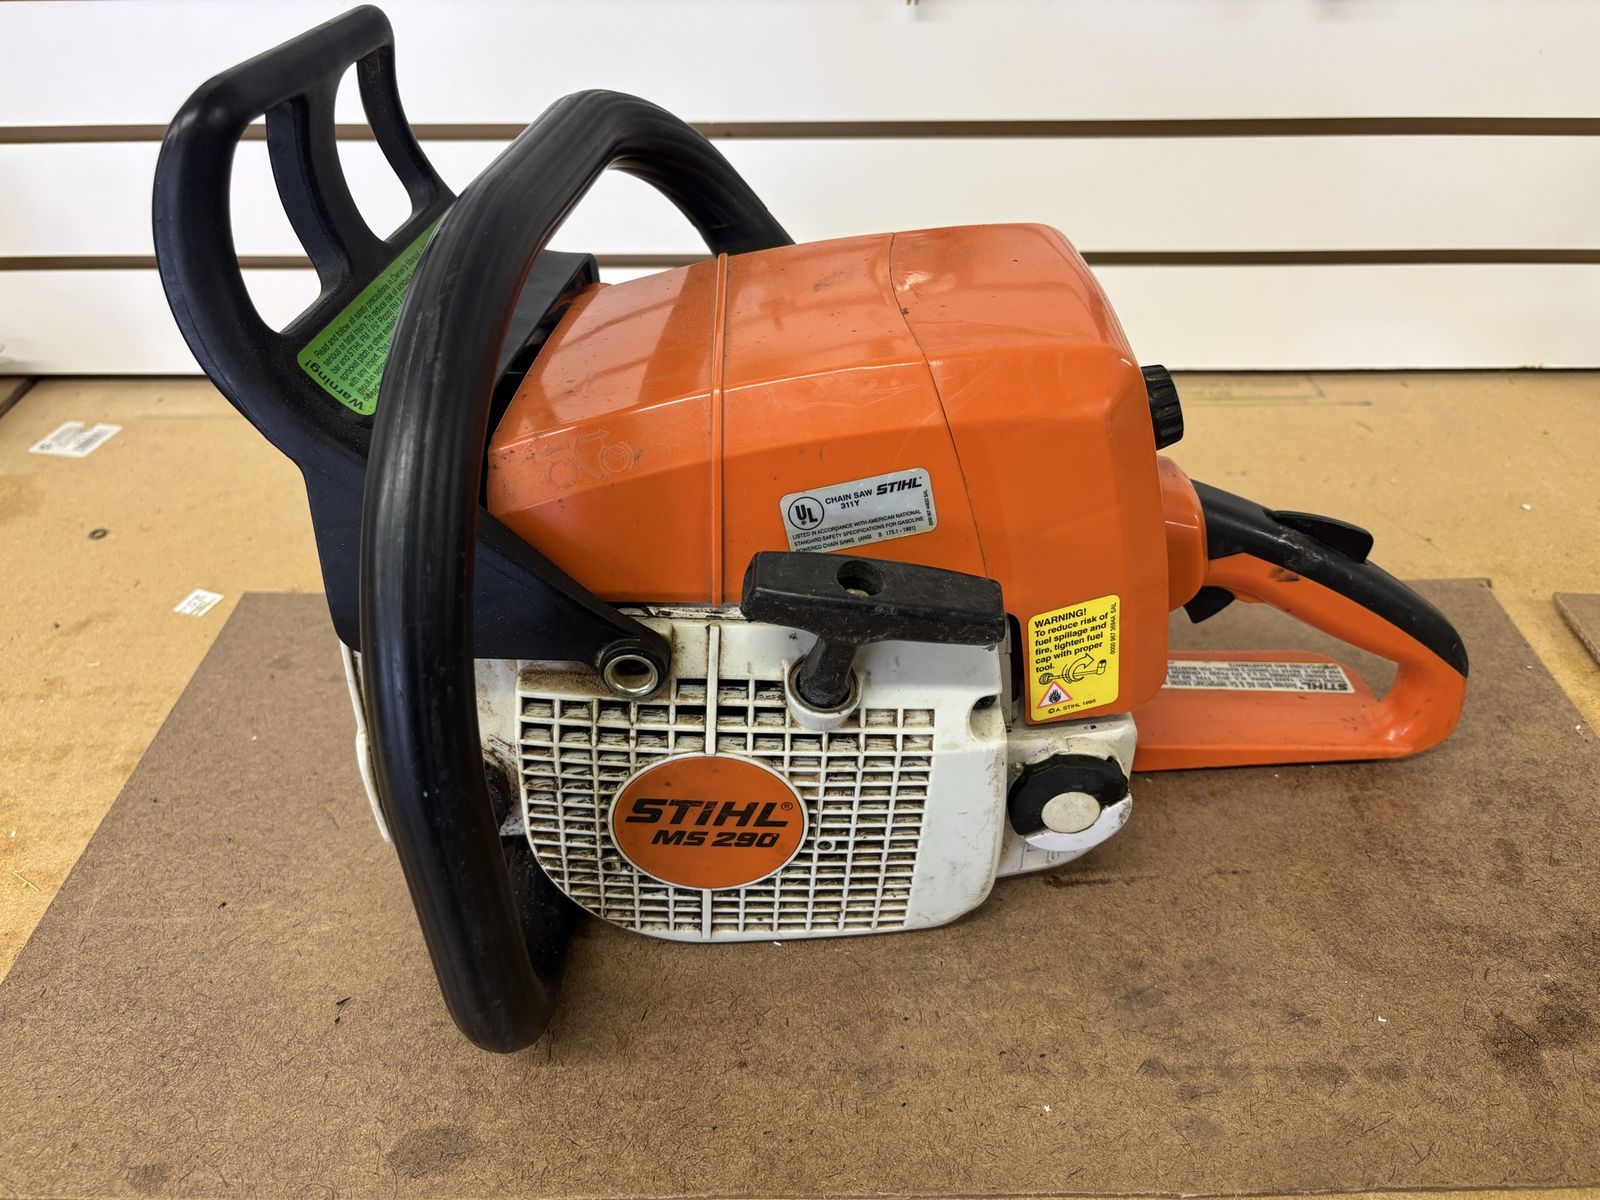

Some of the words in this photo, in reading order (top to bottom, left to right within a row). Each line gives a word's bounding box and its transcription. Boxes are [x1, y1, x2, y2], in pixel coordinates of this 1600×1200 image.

[313, 342, 331, 359] Read
[326, 333, 339, 347] and
[334, 321, 351, 338] follow
[352, 304, 369, 321] safety
[322, 347, 342, 367] serious
[338, 342, 348, 351] or
[343, 332, 356, 346] fatal
[364, 313, 374, 323] To
[369, 299, 388, 318] reduce
[330, 363, 342, 375] bar
[338, 354, 350, 366] and
[346, 339, 364, 357] STIHL
[338, 359, 361, 382] sprocket
[355, 347, 371, 363] pitch
[371, 331, 386, 347] other
[305, 361, 364, 410] Warning!
[825, 493, 852, 505] CHAIN
[853, 489, 873, 499] SAW
[875, 477, 922, 496] STIHL
[795, 504, 818, 523] UL
[840, 499, 860, 510] 311Y
[792, 531, 811, 540] LISTED
[817, 523, 854, 535] ACCORDANCE
[868, 514, 895, 525] AMERICAN
[896, 509, 921, 519] NATIONAL
[794, 537, 822, 547] STANDARD
[822, 533, 842, 541] SAFETY
[842, 524, 885, 537] SPECIFICATIONS
[897, 516, 924, 526] GASOLINE
[823, 541, 839, 549] CHAIN
[1035, 608, 1087, 629] WARNING!
[1036, 629, 1045, 638] To
[1048, 620, 1078, 635] reduce
[1080, 615, 1096, 626] risk
[1099, 612, 1109, 621] of
[1036, 636, 1051, 647] fuel
[1054, 627, 1088, 643] spillage
[1090, 621, 1107, 632] and
[1036, 645, 1052, 657] fire,
[1055, 637, 1084, 652] tighten
[1087, 631, 1103, 642] fuel
[1036, 656, 1051, 666] cap
[1054, 649, 1071, 659] with
[1074, 641, 1104, 655] proper
[1036, 663, 1054, 673] tool.
[1301, 682, 1348, 690] STIHL
[1063, 702, 1080, 711] STIHL
[652, 830, 709, 846] MS
[711, 832, 780, 848] 290
